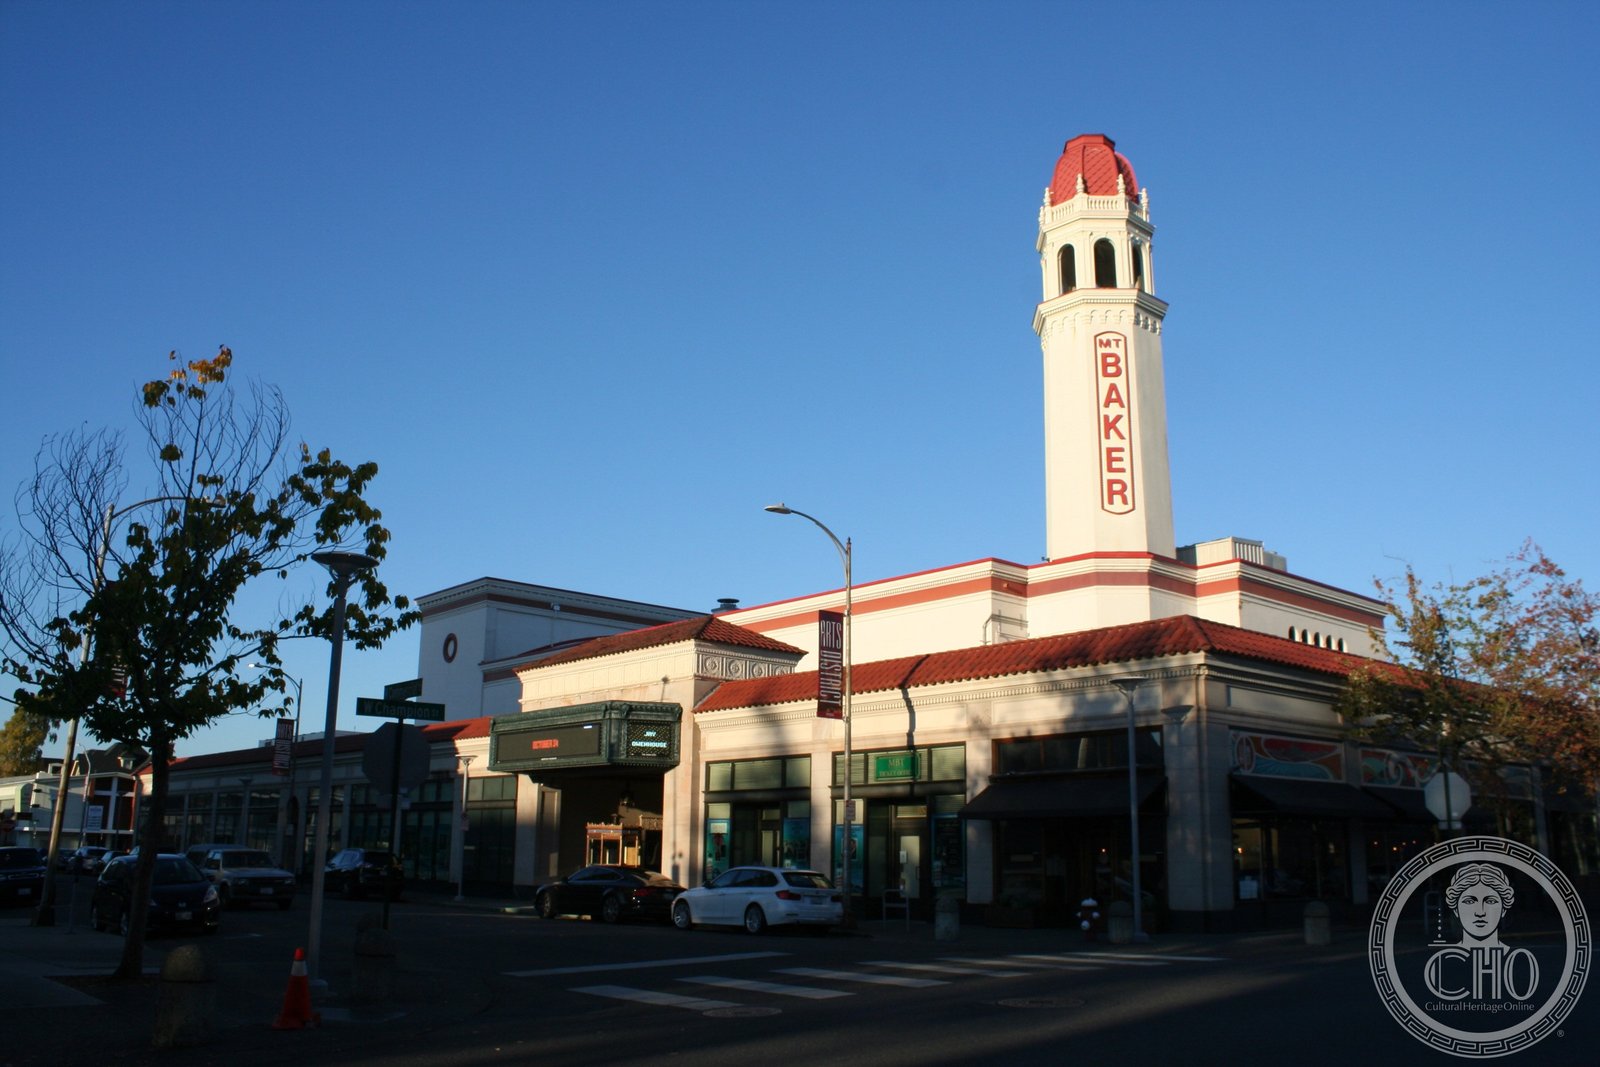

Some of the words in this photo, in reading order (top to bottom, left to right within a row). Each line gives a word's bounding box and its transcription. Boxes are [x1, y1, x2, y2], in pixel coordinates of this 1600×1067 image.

[1098, 338, 1122, 349] MT
[1101, 352, 1128, 505] BAKER
[820, 620, 842, 649] ARTS
[819, 651, 842, 706] DISTRICT
[375, 701, 430, 719] Champion
